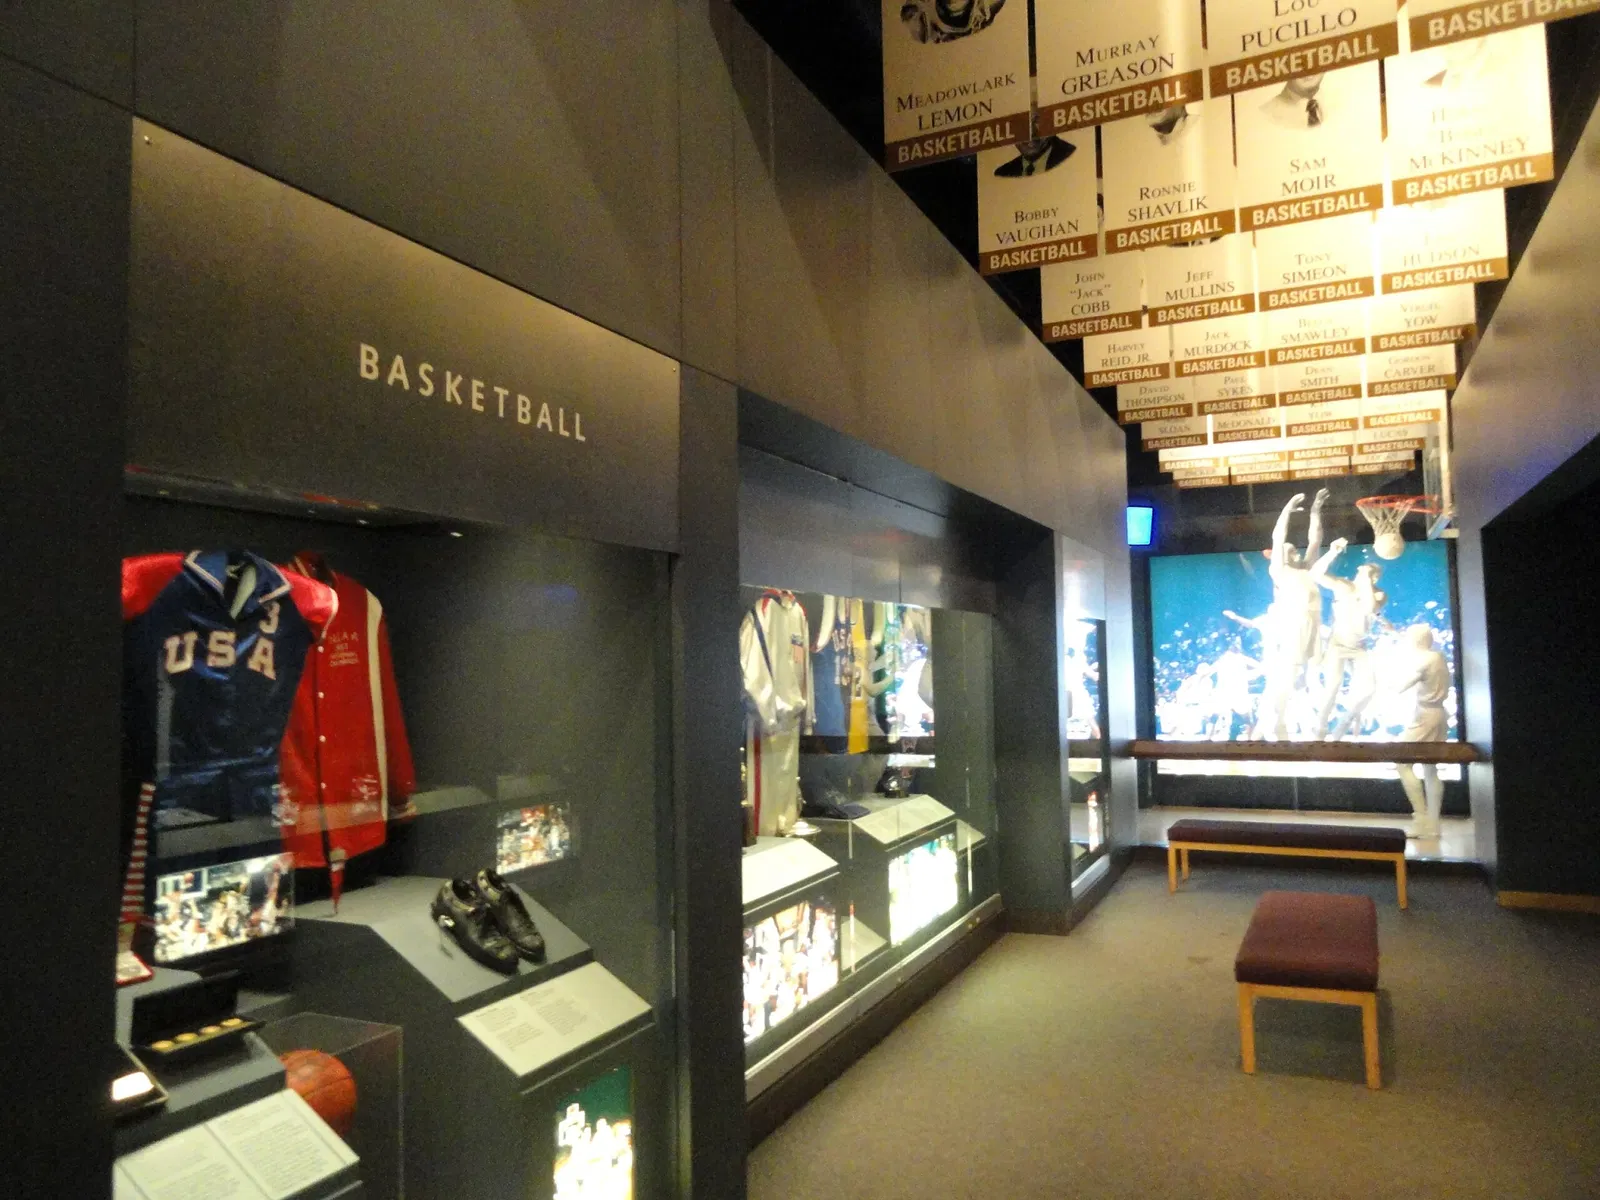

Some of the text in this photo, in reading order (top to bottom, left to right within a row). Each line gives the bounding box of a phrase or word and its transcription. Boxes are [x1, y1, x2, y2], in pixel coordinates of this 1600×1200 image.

[1241, 8, 1357, 52] PUCILLO
[1075, 35, 1160, 68] MURRAY
[1226, 34, 1380, 88] BASKETBALL
[1061, 53, 1175, 95] GREASON
[896, 73, 1015, 113] MEADOWLARK
[1054, 80, 1187, 127] BASKETBALL
[917, 98, 993, 131] LEMON
[898, 121, 1015, 163] BASKETBALL
[1289, 156, 1327, 174] SAM
[1281, 173, 1337, 197] MOIR
[1406, 160, 1537, 199] BASKETBALL
[1139, 182, 1196, 201] RONNIE
[1014, 207, 1059, 224] BOBBY
[1127, 195, 1209, 223] SHAVLIK
[1252, 192, 1370, 225] BASKETBALL
[995, 219, 1080, 245] VAUGHAN
[1117, 216, 1223, 248] BASKETBALL
[990, 240, 1087, 269] BASKETBALL
[1294, 252, 1332, 266] TONY
[1074, 272, 1105, 285] JOHN
[1184, 270, 1214, 284] JEFF
[1282, 265, 1347, 285] SIMEON
[1391, 262, 1495, 290] BASKETBALL
[1165, 281, 1235, 302] MULLINS
[1268, 282, 1363, 307] BASKETBALL
[1071, 300, 1110, 316] COBB
[1157, 299, 1245, 323] BASKETBALL
[1052, 315, 1133, 338] BASKETBALL
[1403, 314, 1438, 329] YOW
[1379, 328, 1465, 350] BASKETBALL
[1107, 343, 1145, 355] HARVEY
[1184, 340, 1252, 358] MURDOCK
[1277, 341, 1357, 362] BASKETBALL
[1183, 355, 1257, 374] BASKETBALL
[1384, 365, 1436, 379] CARVER
[1092, 367, 1162, 385] BASKETBALL
[1300, 376, 1339, 389] SMITH
[359, 343, 587, 442] BASKETBALL
[1218, 385, 1254, 397] SYKES
[1286, 386, 1355, 404] BASKETBALL
[1374, 377, 1447, 395] BASKETBALL
[1125, 393, 1185, 408] THOMPSON
[1204, 398, 1269, 414] BASKETBALL
[1124, 407, 1188, 422] BASKETBALL
[1370, 411, 1433, 426] BASKETBALL
[1218, 429, 1276, 442] BASKETBALL
[1291, 421, 1352, 435] BASKETBALL
[1148, 436, 1202, 449] BASKETBALL
[1363, 439, 1420, 452] BASKETBALL
[1294, 447, 1348, 459] BASKETBALL
[163, 630, 277, 681] USA
